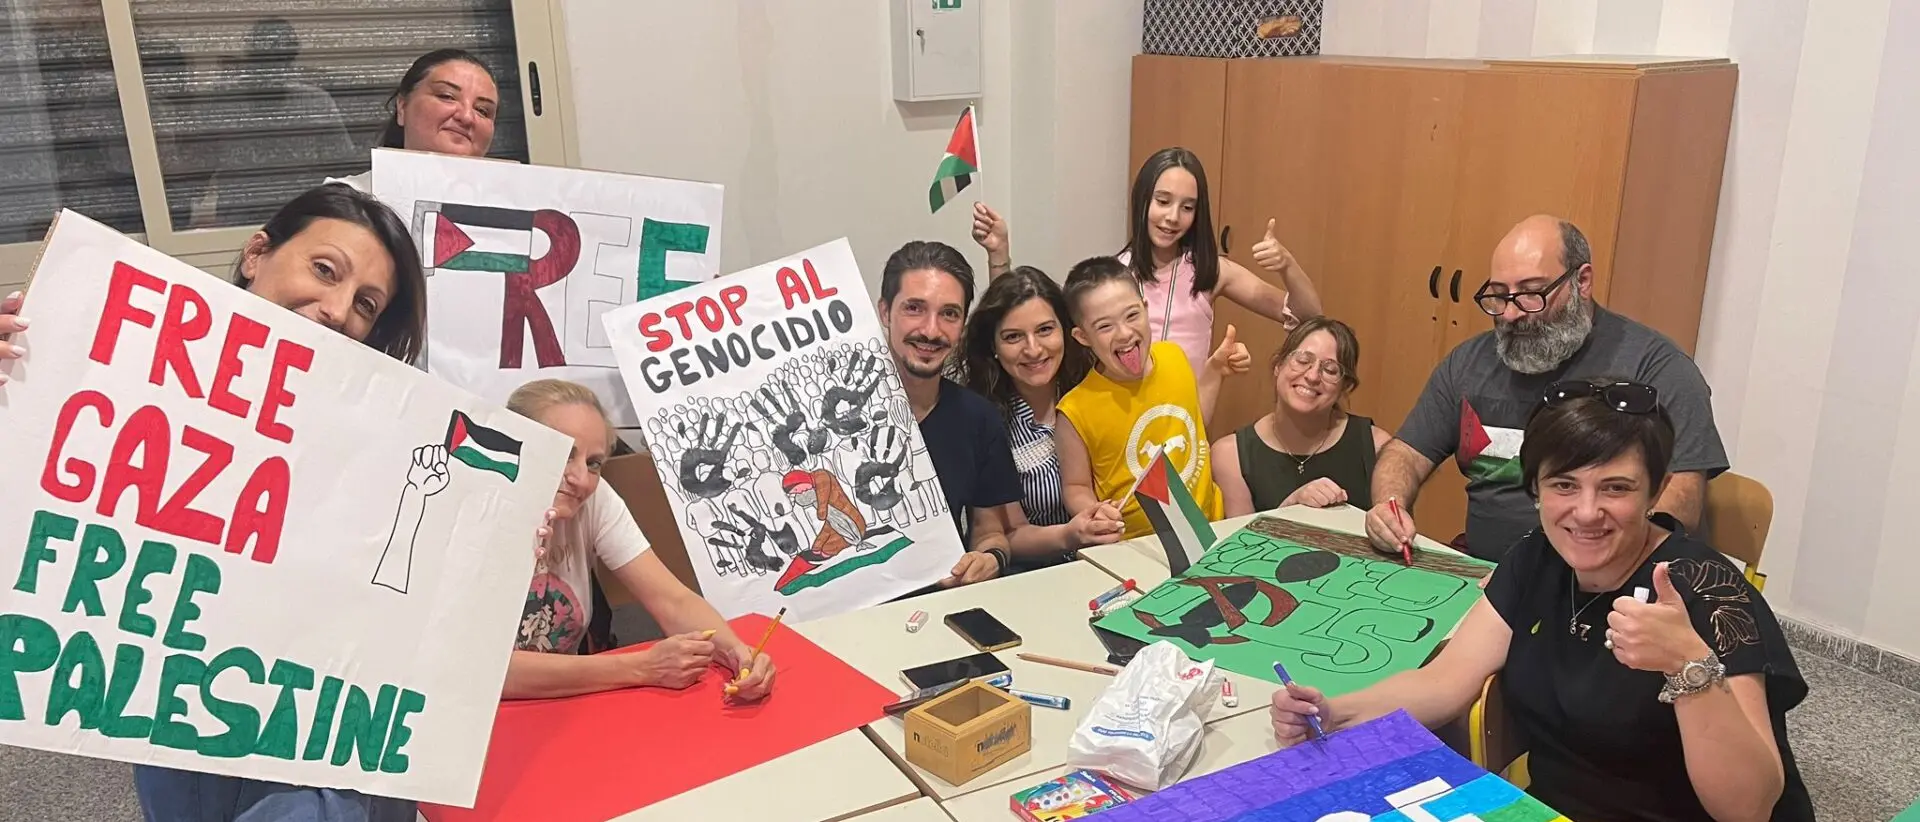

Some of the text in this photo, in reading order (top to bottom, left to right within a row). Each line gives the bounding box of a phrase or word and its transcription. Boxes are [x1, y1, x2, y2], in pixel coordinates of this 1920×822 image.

[88, 260, 316, 444] FREE
[639, 258, 838, 352] STOP AL
[640, 300, 853, 393] GENOCIDIO
[40, 390, 292, 564] GAZA
[13, 510, 222, 652] FREE
[0, 613, 427, 774] PALESTINE
